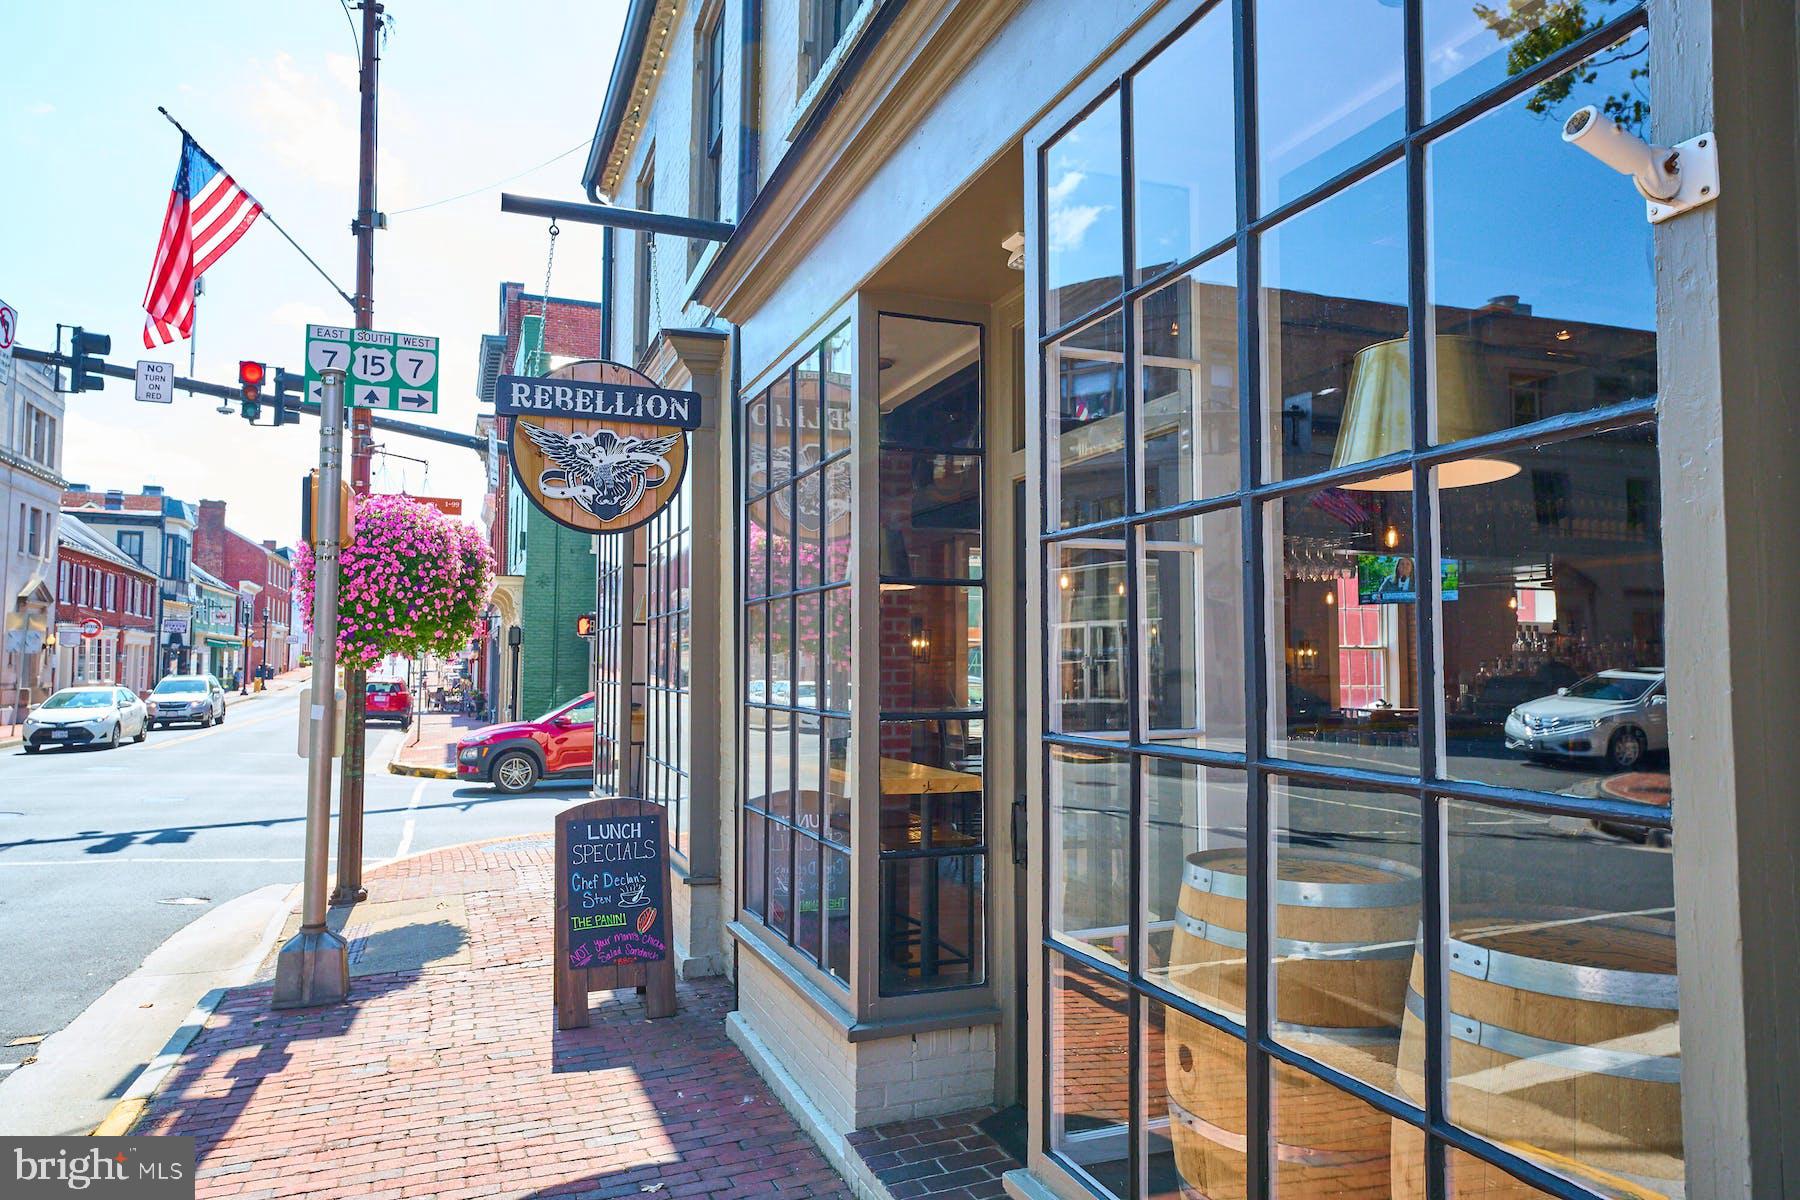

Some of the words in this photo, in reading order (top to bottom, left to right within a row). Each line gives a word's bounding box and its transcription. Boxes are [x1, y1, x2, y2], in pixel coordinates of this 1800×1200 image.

[317, 328, 344, 339] EAST
[357, 332, 391, 344] SOUTH
[403, 337, 430, 348] WEST
[322, 349, 338, 367] 7
[362, 354, 385, 376] 15
[147, 365, 163, 373] NO
[408, 358, 424, 379] 7
[144, 374, 166, 382] TURN
[146, 392, 162, 400] RED
[510, 382, 690, 421] REBELLION
[587, 823, 641, 840] LUNCH
[572, 839, 656, 865] SPECIALS
[572, 872, 599, 891] Chef
[583, 891, 612, 908] Stew
[571, 915, 592, 928] THE
[594, 913, 627, 926] PANINI
[570, 943, 590, 963] NOT
